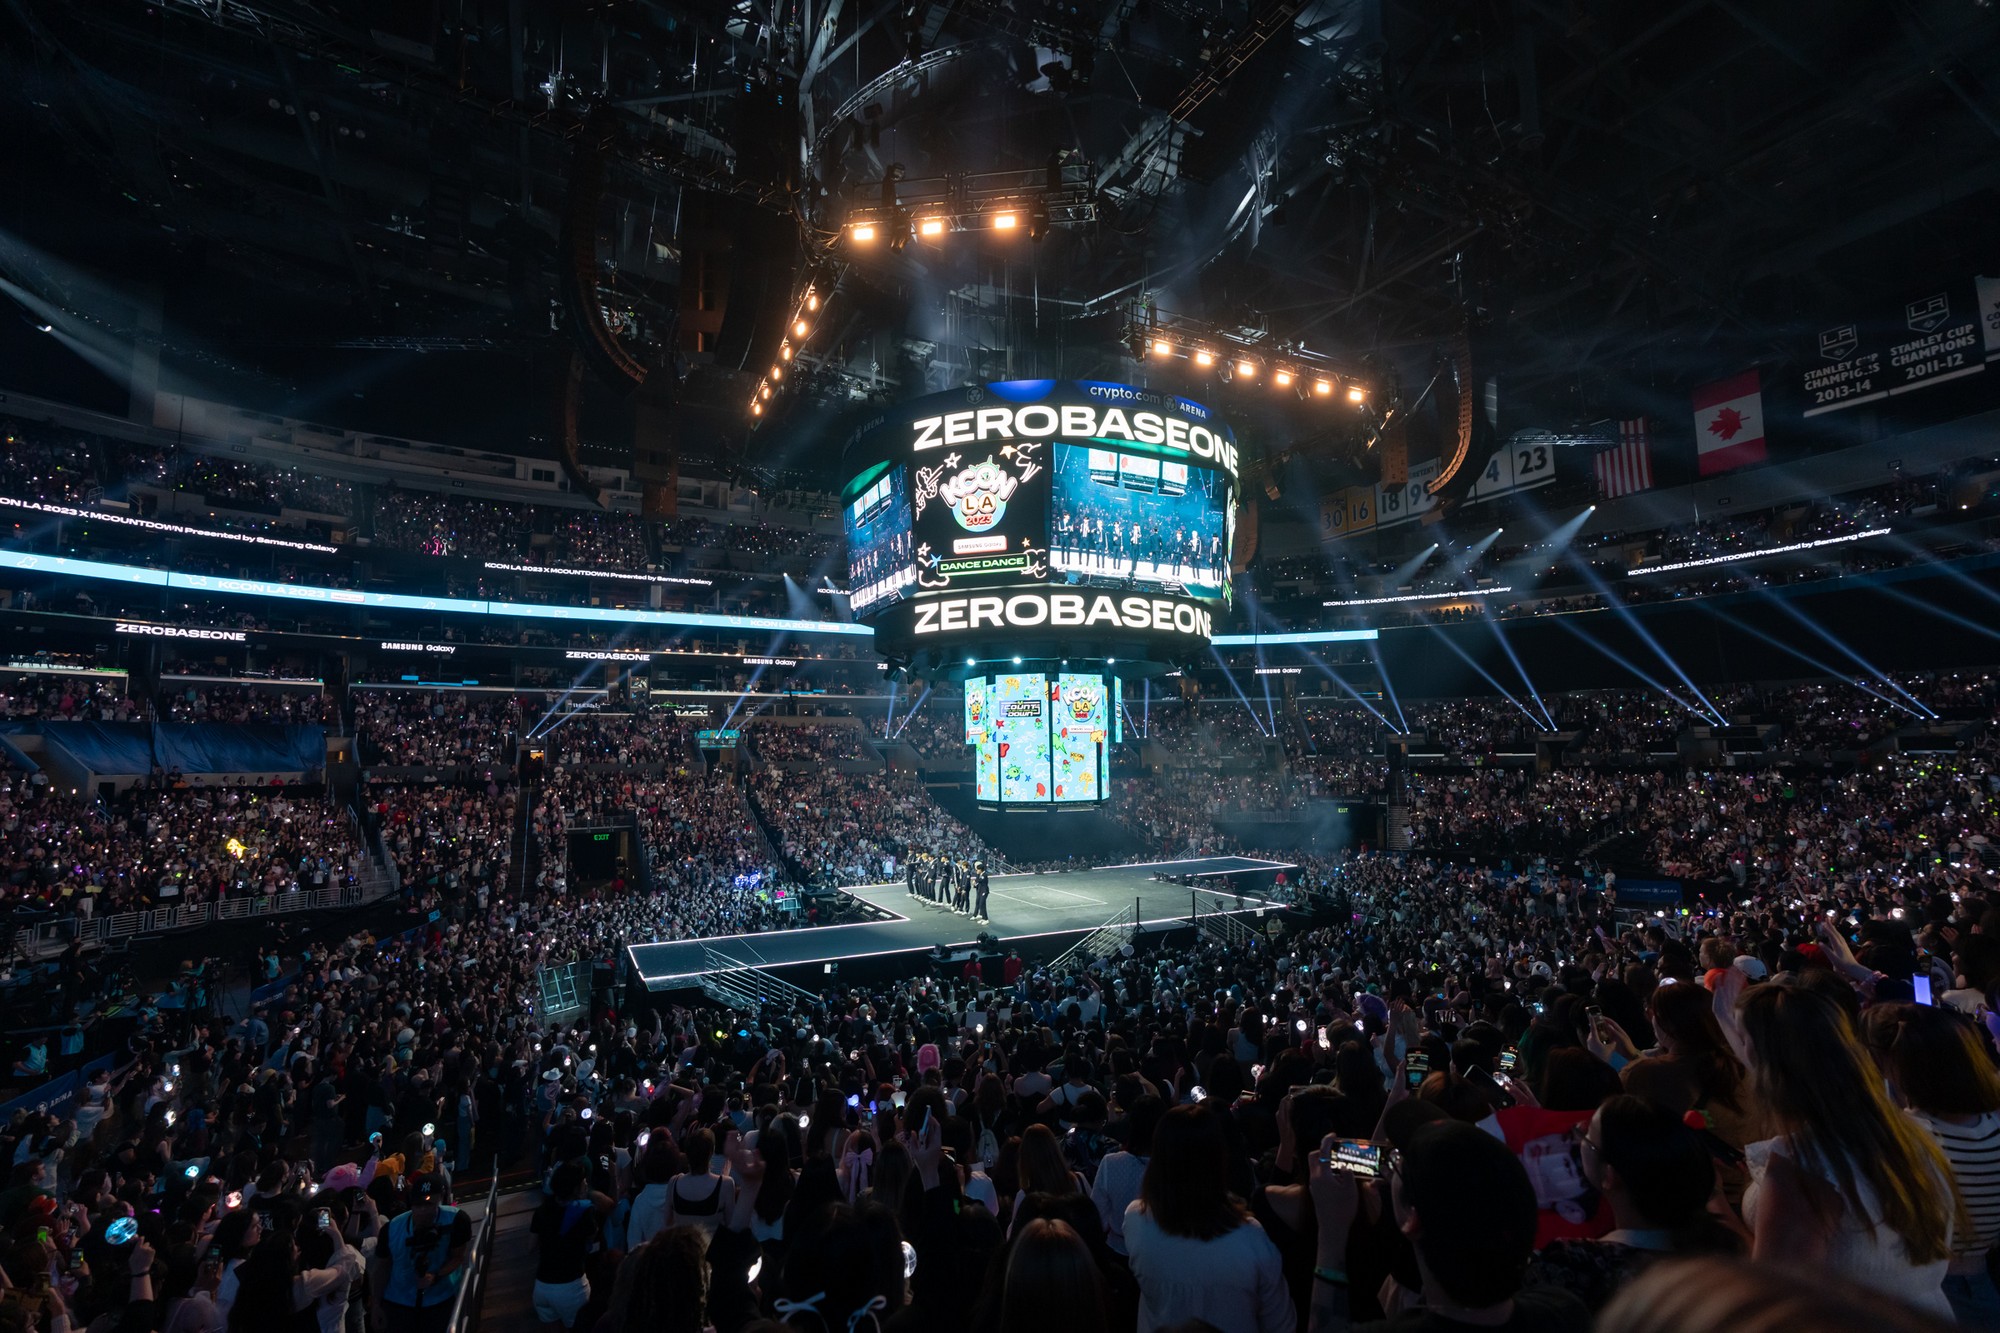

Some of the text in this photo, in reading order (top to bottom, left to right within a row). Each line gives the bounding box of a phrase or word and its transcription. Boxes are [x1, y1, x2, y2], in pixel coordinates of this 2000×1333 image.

[1889, 324, 1975, 357] STANLEY CUP
[1891, 334, 1976, 367] CHAMPIONS
[1803, 360, 1853, 381] STANLEY
[1905, 353, 1965, 380] 2011-12
[1089, 385, 1207, 419] crypto.com ARENA
[1815, 379, 1872, 404] 2013-14
[914, 405, 1239, 478] ZEROBASEONE
[1519, 446, 1547, 475] 23
[1352, 501, 1369, 522] 16
[1381, 493, 1400, 514] 18
[23, 501, 42, 510] LA
[43, 504, 78, 517] 2023
[78, 510, 89, 518] X
[90, 512, 183, 533] MCOUNTDOWN
[184, 527, 241, 541] Presented
[242, 534, 256, 544] by
[256, 536, 304, 550] Samsung
[305, 543, 338, 554] Galaxy
[965, 514, 993, 527] 2023
[1324, 509, 1344, 529] 30
[1627, 568, 1651, 576] KCON
[1662, 563, 1684, 571] 2023
[1756, 543, 1801, 556] Presented
[1801, 541, 1813, 549] by
[1814, 534, 1858, 546] Samsung
[1858, 527, 1891, 538] Galaxy
[484, 561, 510, 570] KCON
[522, 565, 543, 573] 2023
[550, 568, 610, 578] MCOUNTDOWN
[610, 572, 647, 581] Presented
[648, 574, 657, 582] by
[657, 576, 689, 585] Samsung
[940, 557, 1024, 572] DANCE DANCE
[218, 580, 264, 593] KCON
[266, 585, 287, 595] LA
[288, 588, 325, 598] 2023
[1371, 595, 1418, 604] MCOUNTDOWN
[115, 623, 246, 641] ZEROBASEONE
[750, 620, 778, 628] KCON
[381, 642, 456, 654] SAMSUNG Galaxy
[565, 651, 650, 662] ZEROBASEONE
[774, 658, 797, 667] Galaxy
[1282, 667, 1302, 675] Galaxy
